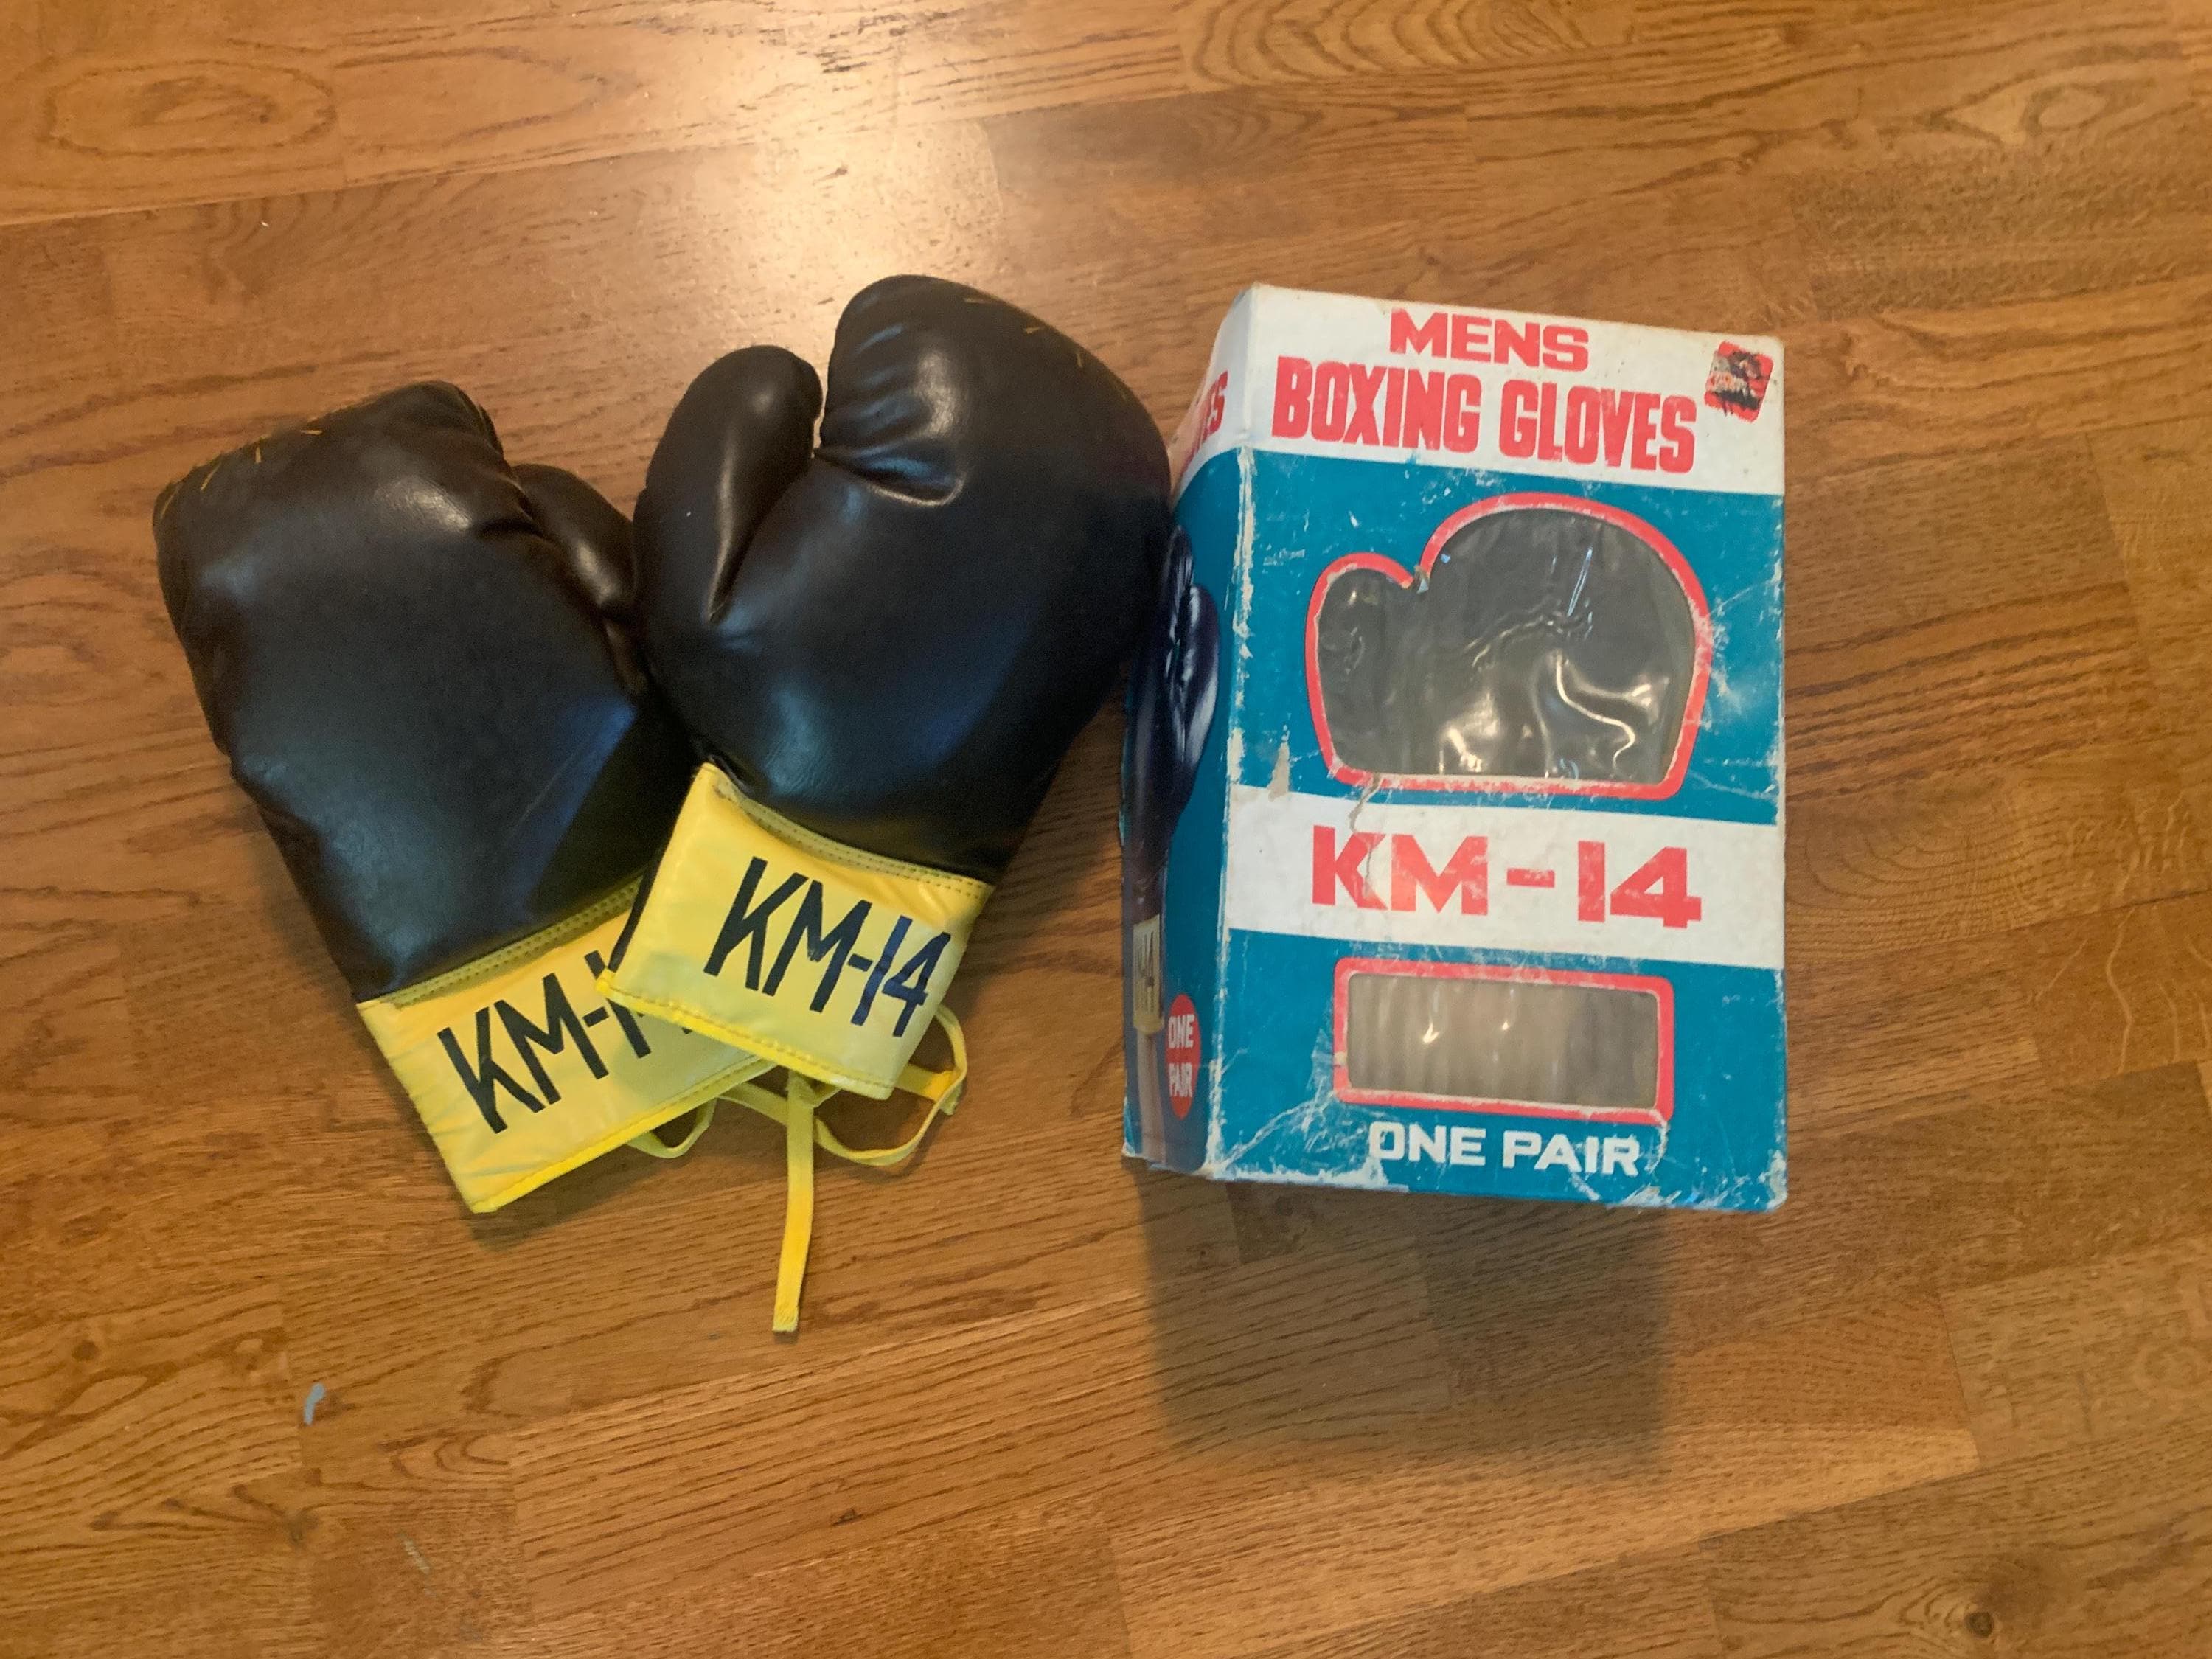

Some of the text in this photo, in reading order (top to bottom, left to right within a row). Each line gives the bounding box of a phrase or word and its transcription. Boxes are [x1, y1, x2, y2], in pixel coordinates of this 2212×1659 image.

[1388, 307, 1589, 372] MENS
[1271, 355, 1481, 453] BOXING
[1498, 379, 1697, 474] GLOVES
[1312, 825, 1702, 929] KM-14
[703, 855, 953, 1038] KM-14
[437, 950, 693, 1134] KM-1
[1168, 1013, 1195, 1049] ONE
[1169, 1062, 1193, 1098] PAIR
[1369, 1121, 1641, 1177] ONE PAIR
